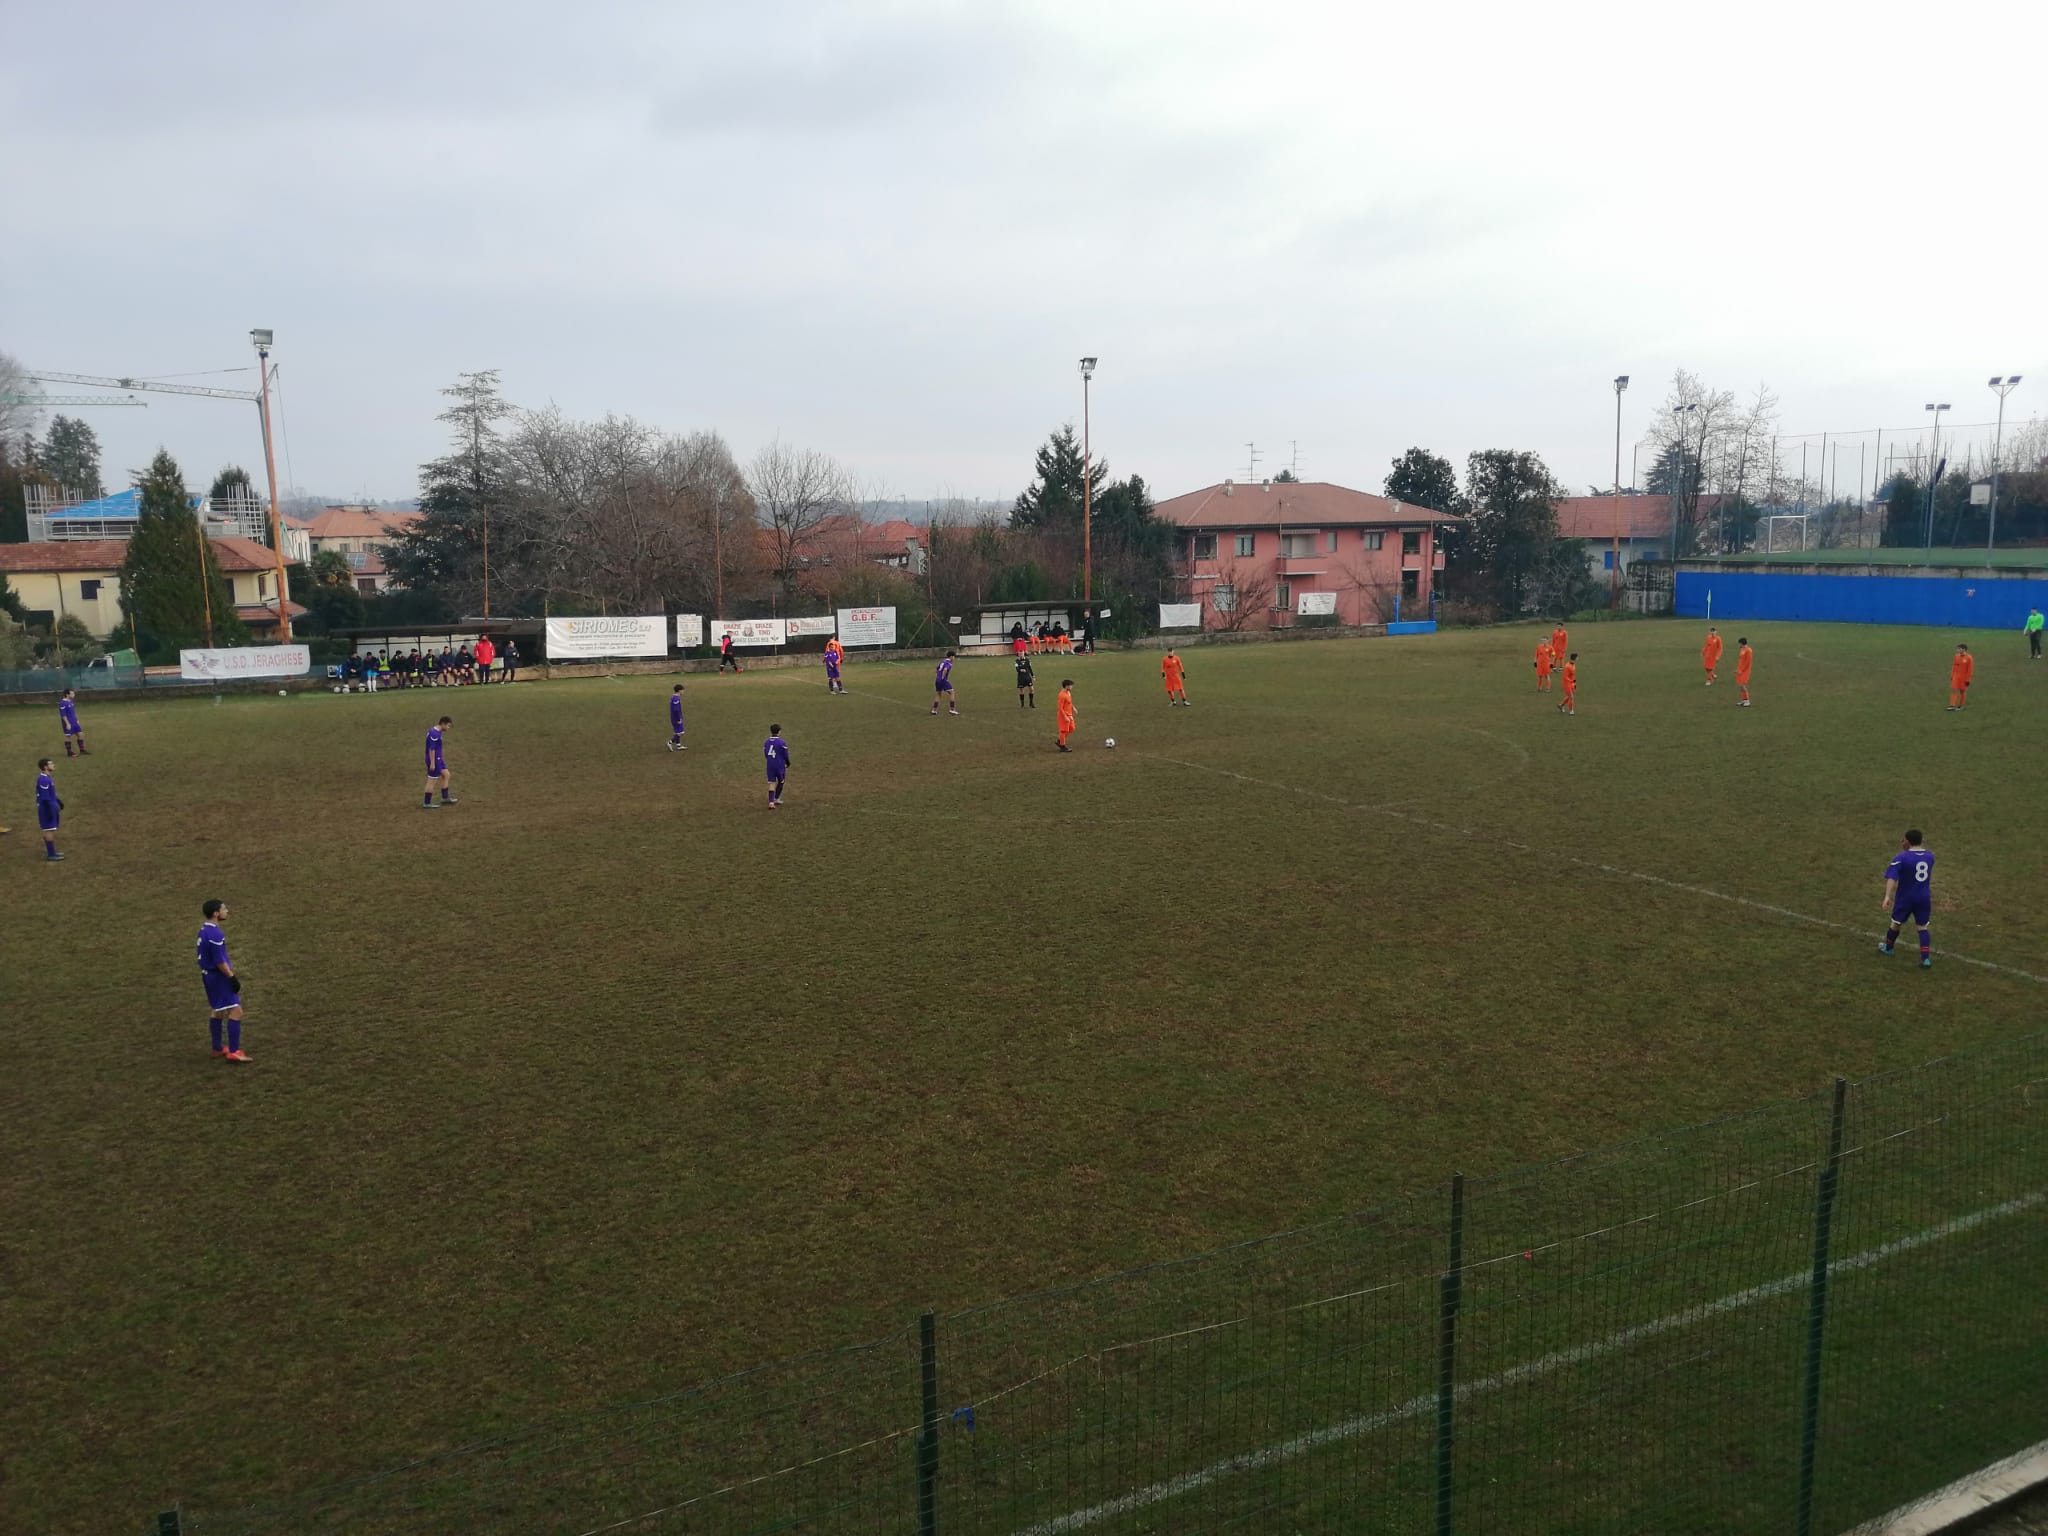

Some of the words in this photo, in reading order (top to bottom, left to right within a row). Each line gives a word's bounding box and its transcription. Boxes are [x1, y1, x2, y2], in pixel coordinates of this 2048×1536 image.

[571, 619, 638, 634] SIRIOMEC
[253, 652, 304, 668] JERAGHESE
[767, 744, 777, 758] 4
[1915, 861, 1929, 882] 8
